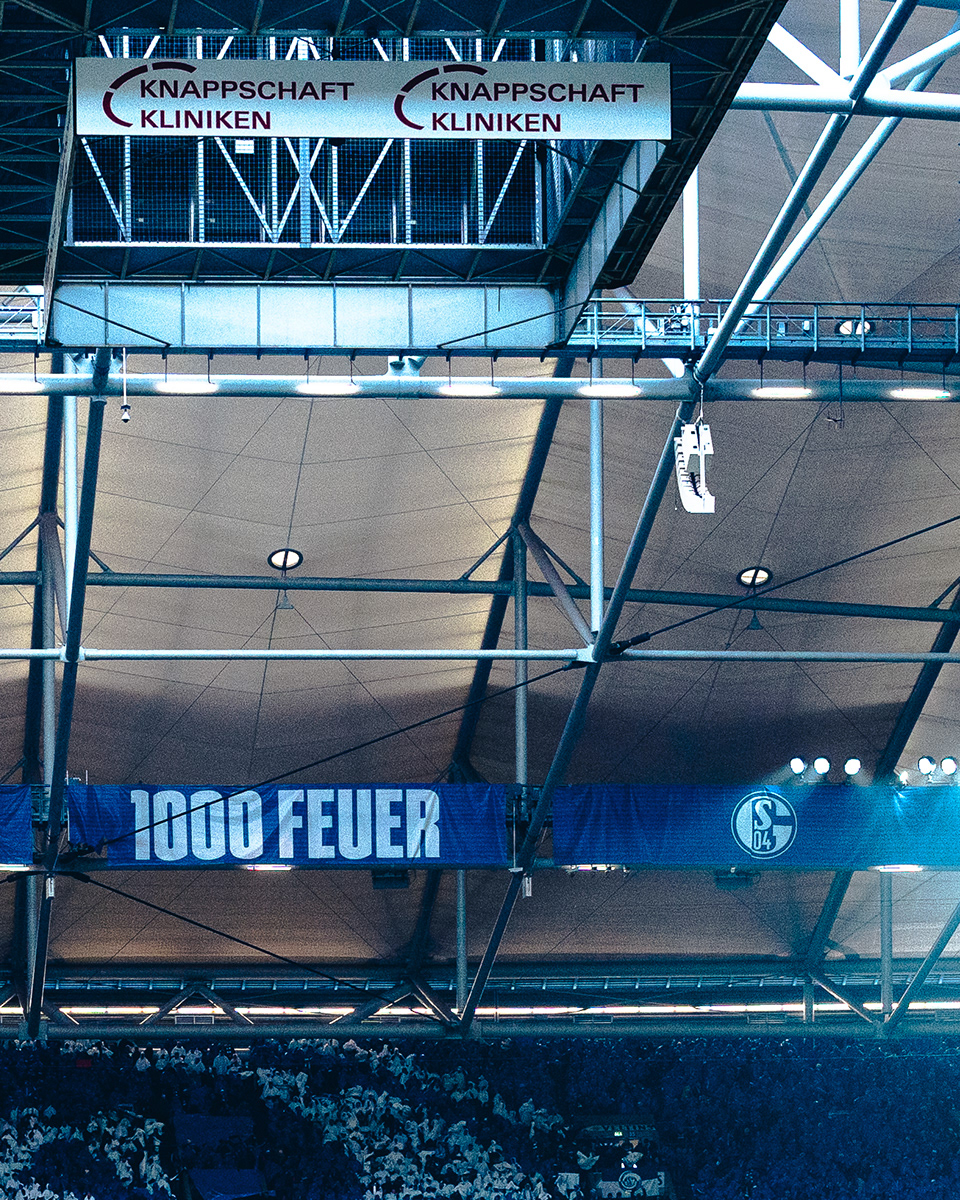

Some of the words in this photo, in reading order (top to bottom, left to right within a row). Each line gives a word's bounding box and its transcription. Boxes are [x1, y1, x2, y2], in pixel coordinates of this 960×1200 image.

[140, 79, 355, 101] KNAPPSCHAFT
[431, 82, 645, 103] KNAPPSCHAFT
[140, 109, 271, 130] KLINIKEN
[431, 112, 562, 132] KLINIKEN
[130, 788, 264, 862] 1000
[278, 788, 440, 860] FEUER
